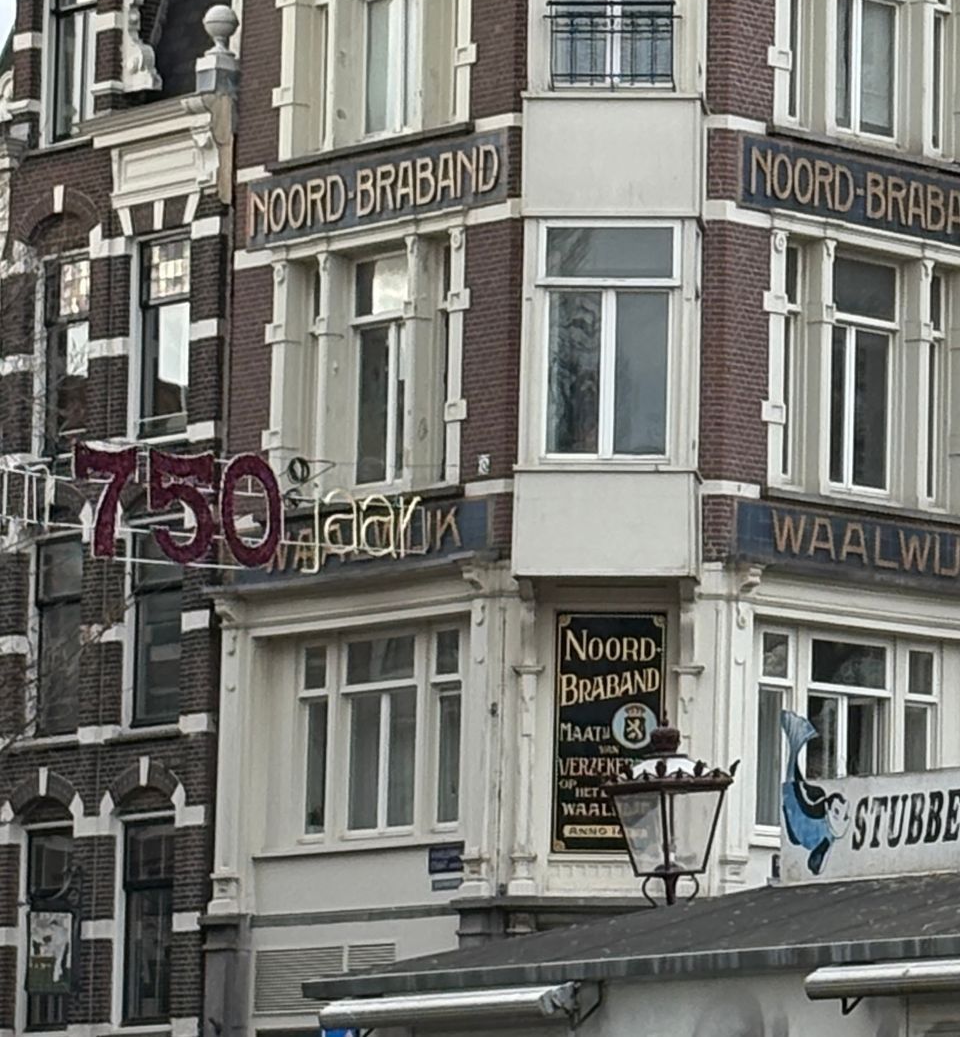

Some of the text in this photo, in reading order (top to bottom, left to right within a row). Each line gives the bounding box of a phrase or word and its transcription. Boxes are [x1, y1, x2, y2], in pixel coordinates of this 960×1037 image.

[250, 144, 499, 238] NOORD-BRABAND
[72, 439, 283, 569] 750
[565, 629, 663, 661] NOORD-
[560, 668, 660, 706] BRABAND
[559, 778, 577, 789] OP
[568, 826, 608, 836] ANNO
